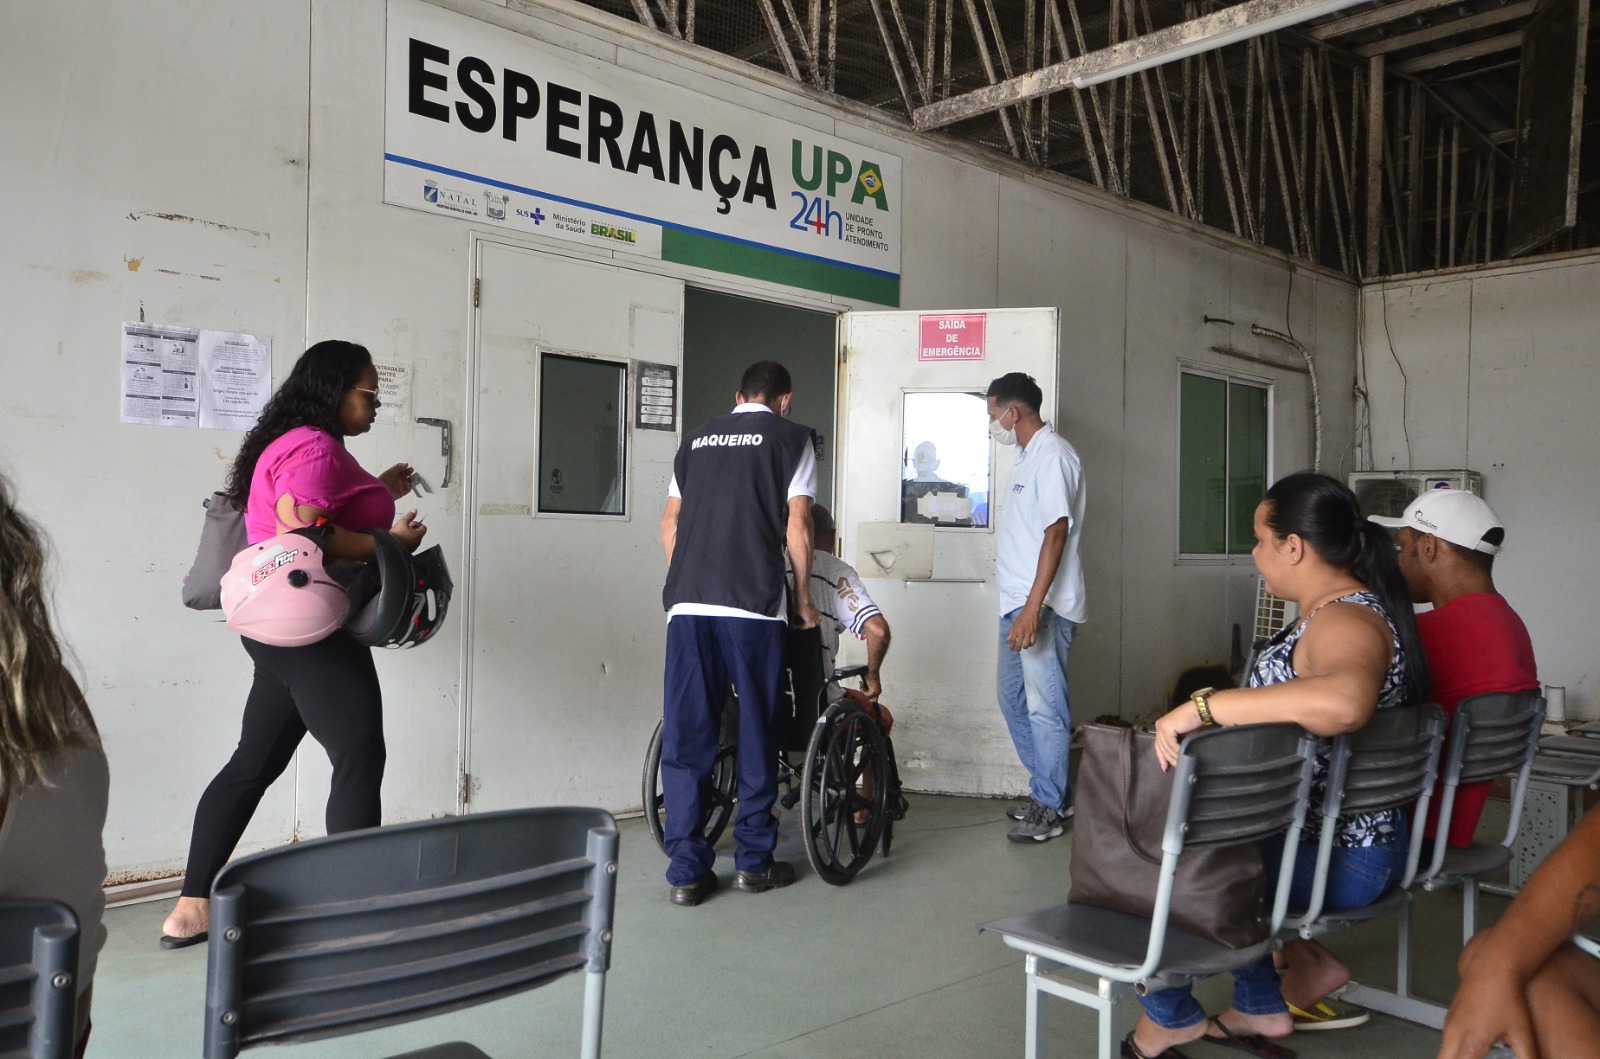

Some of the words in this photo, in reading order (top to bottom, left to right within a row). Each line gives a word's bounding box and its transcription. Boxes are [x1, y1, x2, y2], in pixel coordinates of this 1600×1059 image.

[408, 37, 777, 215] ESPERANÇA
[791, 138, 889, 212] UPA
[440, 191, 477, 206] NATAL
[516, 208, 529, 218] SUS
[553, 213, 586, 227] Ministério
[790, 191, 842, 240] 24h
[846, 212, 873, 227] UNIDADE
[556, 222, 564, 230] da
[566, 224, 586, 235] Saúde
[591, 223, 636, 244] BRASIL
[846, 223, 854, 233] DE
[857, 226, 883, 240] PRONTO
[845, 235, 889, 252] ATENDIMENTO
[939, 319, 966, 330] SAÍDA
[946, 334, 958, 343] DE
[923, 346, 981, 356] EMERGÊNCIA
[691, 434, 763, 451] MAQUEIRO
